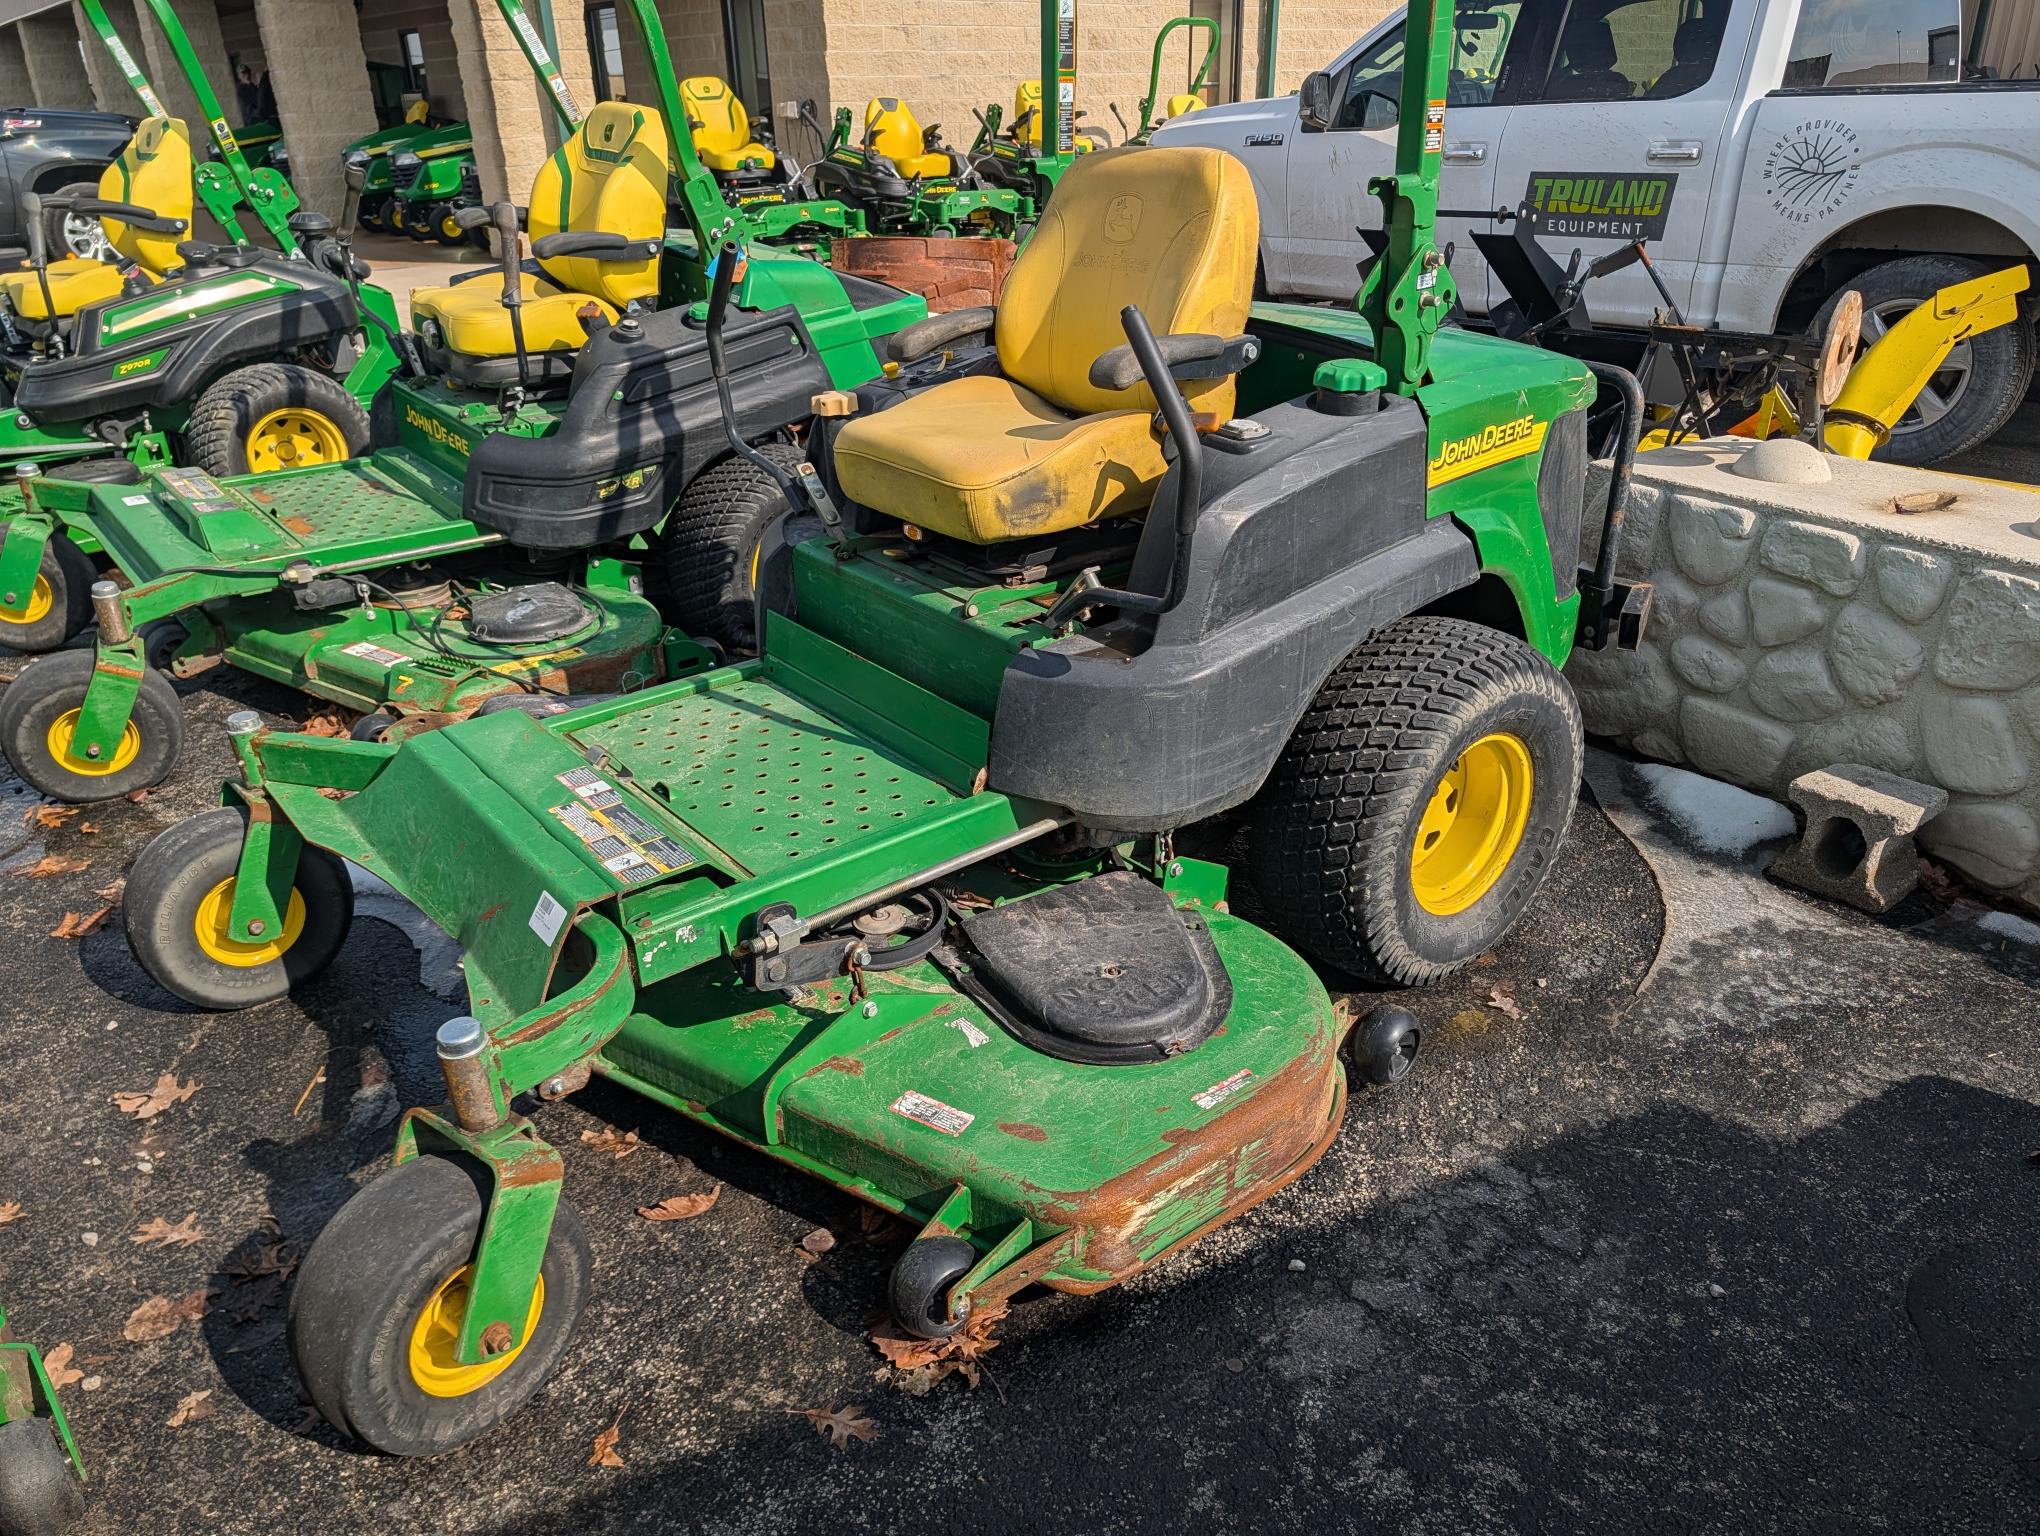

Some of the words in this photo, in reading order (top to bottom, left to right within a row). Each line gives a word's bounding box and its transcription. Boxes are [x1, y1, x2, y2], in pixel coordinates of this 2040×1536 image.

[1763, 134, 1791, 179] WHERE
[1796, 119, 1857, 144] PROVIDER
[1534, 178, 1668, 216] TRULAND
[1771, 200, 1810, 223] MEANS
[1818, 163, 1861, 220] PARTNER
[1548, 219, 1643, 235] EQUIPMENT
[120, 358, 151, 375] Z970R
[406, 404, 433, 435] JOHN
[1433, 433, 1482, 470] JOHN
[1481, 413, 1535, 453] DEERE
